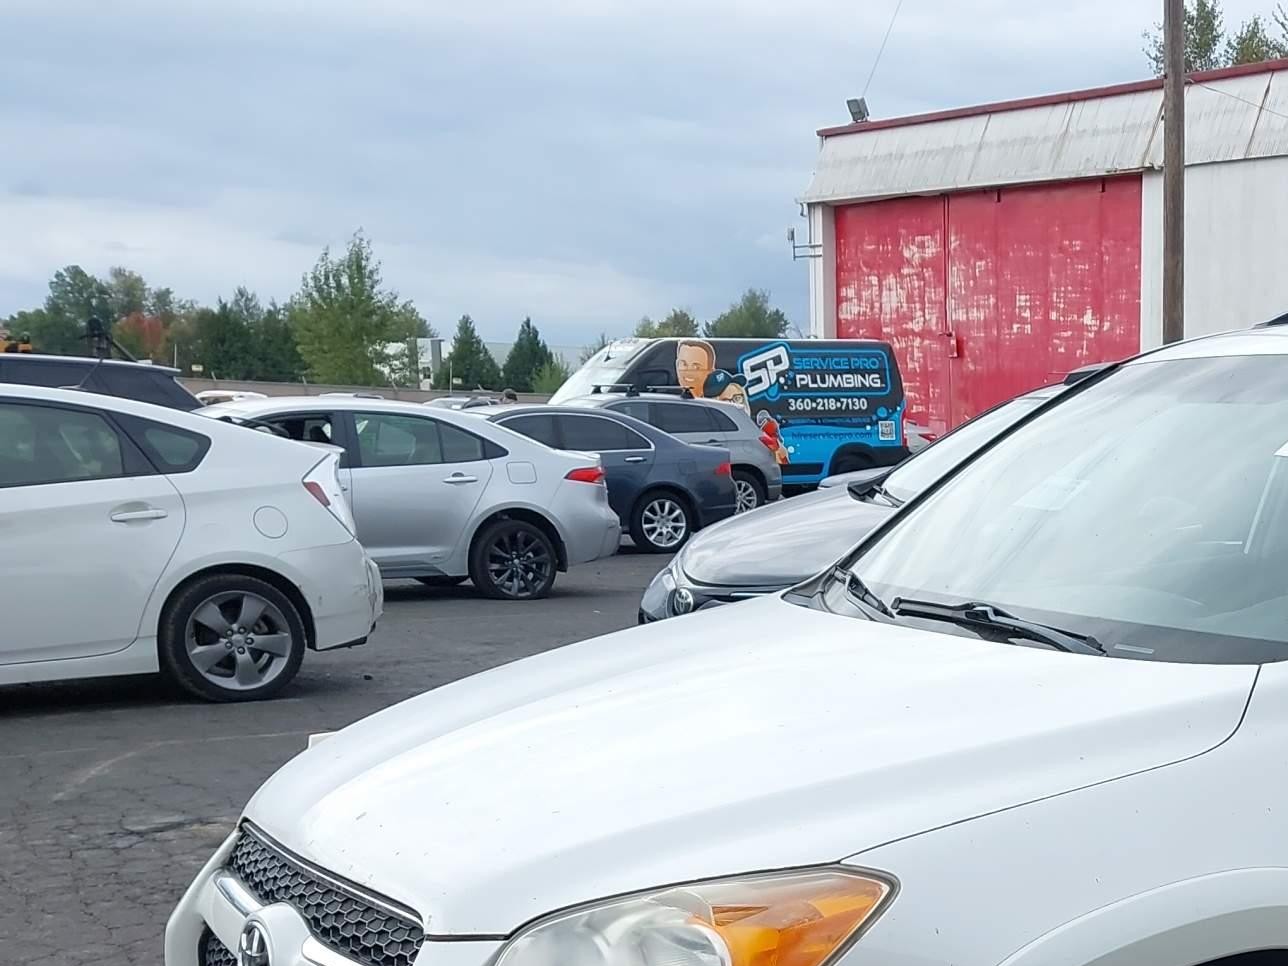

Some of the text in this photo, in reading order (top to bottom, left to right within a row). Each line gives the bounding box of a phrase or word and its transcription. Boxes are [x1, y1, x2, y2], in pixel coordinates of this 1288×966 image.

[793, 358, 879, 369] SERVICE PRO
[796, 374, 881, 388] PLUMBING
